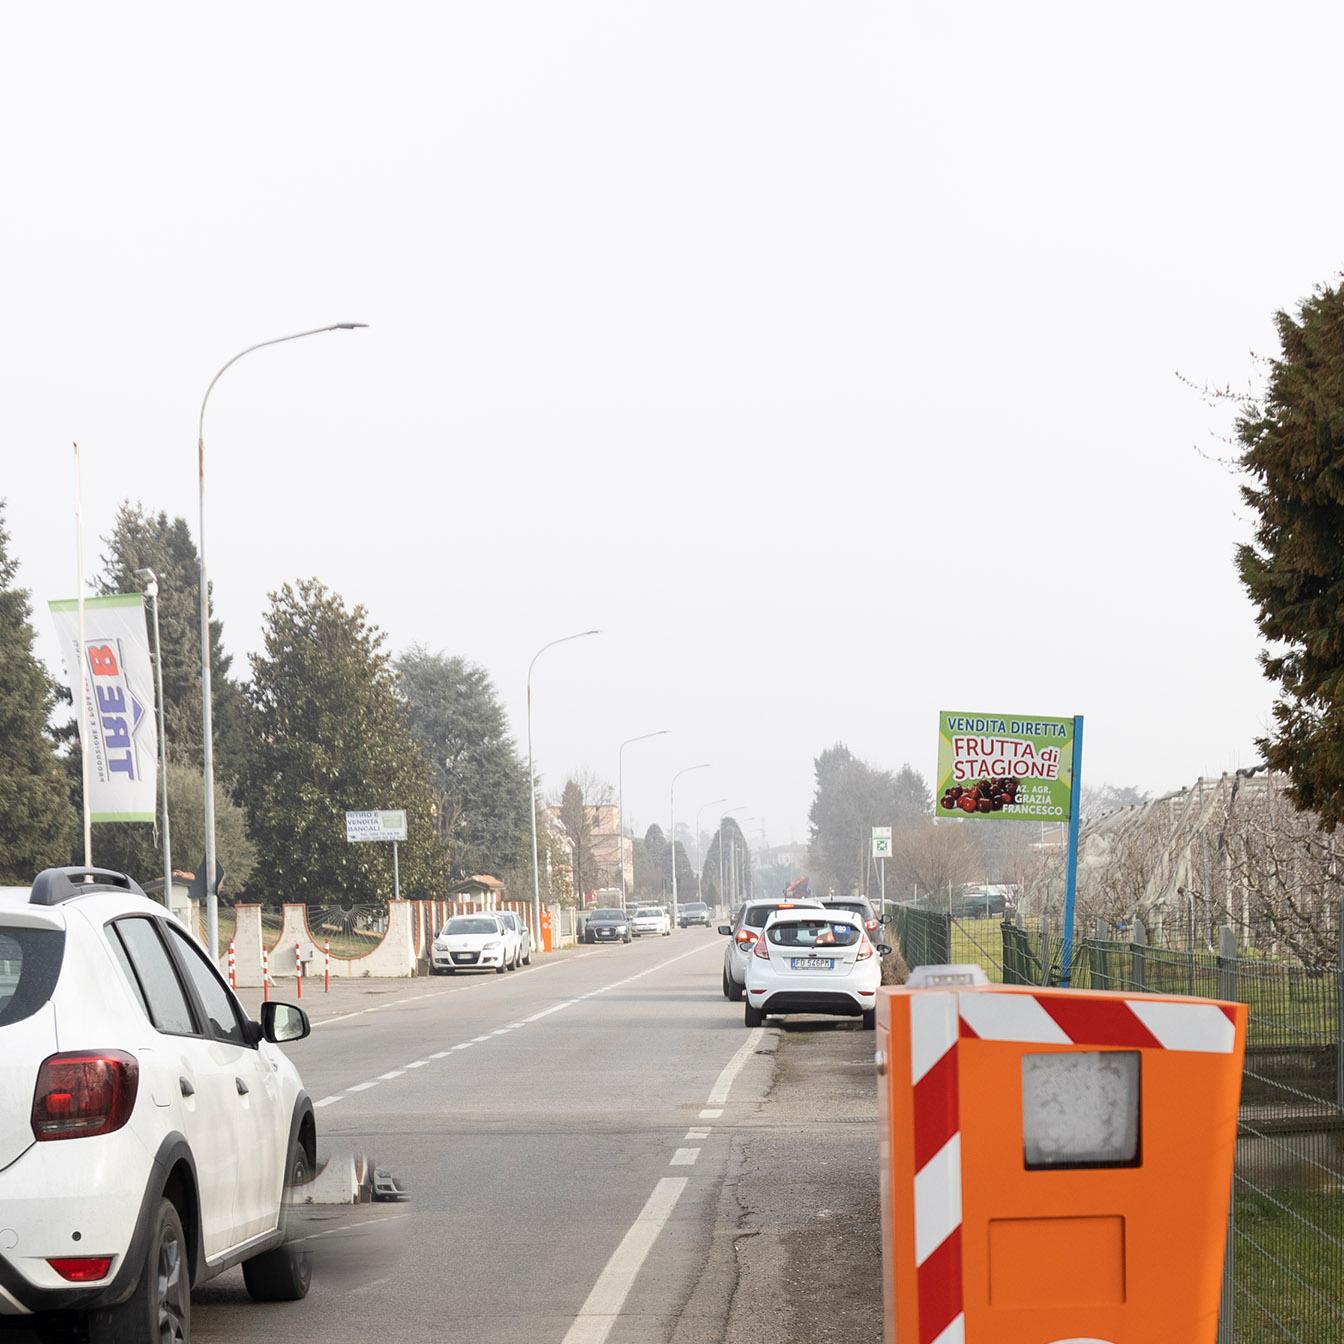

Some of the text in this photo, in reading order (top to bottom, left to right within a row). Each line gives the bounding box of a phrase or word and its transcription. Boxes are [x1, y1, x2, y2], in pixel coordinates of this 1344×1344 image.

[948, 718, 1066, 737] VENDITA DIRETTA
[954, 738, 1059, 764] FRUTTA di
[954, 760, 1058, 780] STAGIONE
[1016, 785, 1052, 794] AZ. AGR.
[1014, 794, 1052, 805] GRAZIA
[1002, 804, 1063, 816] FRANCESCO
